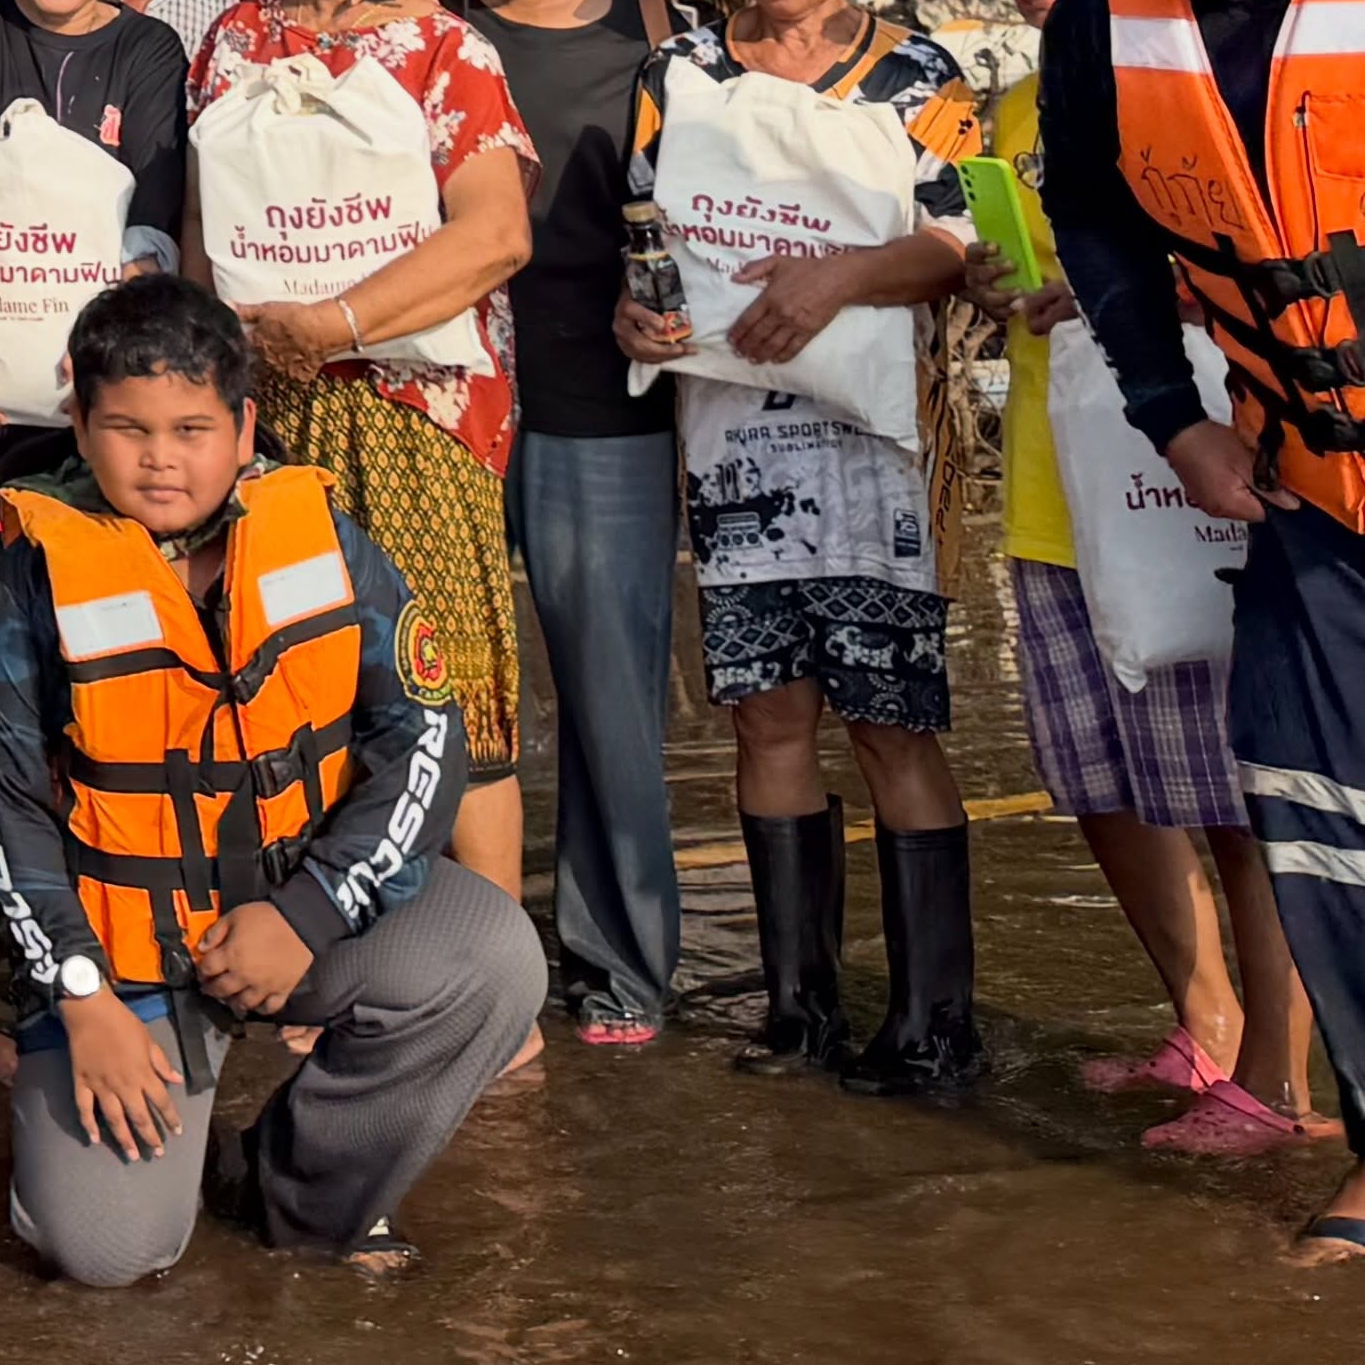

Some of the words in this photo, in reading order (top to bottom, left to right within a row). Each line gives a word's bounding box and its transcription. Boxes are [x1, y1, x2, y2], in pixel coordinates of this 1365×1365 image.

[265, 192, 392, 242] ถุงยังชีพ
[42, 297, 70, 314] Fin
